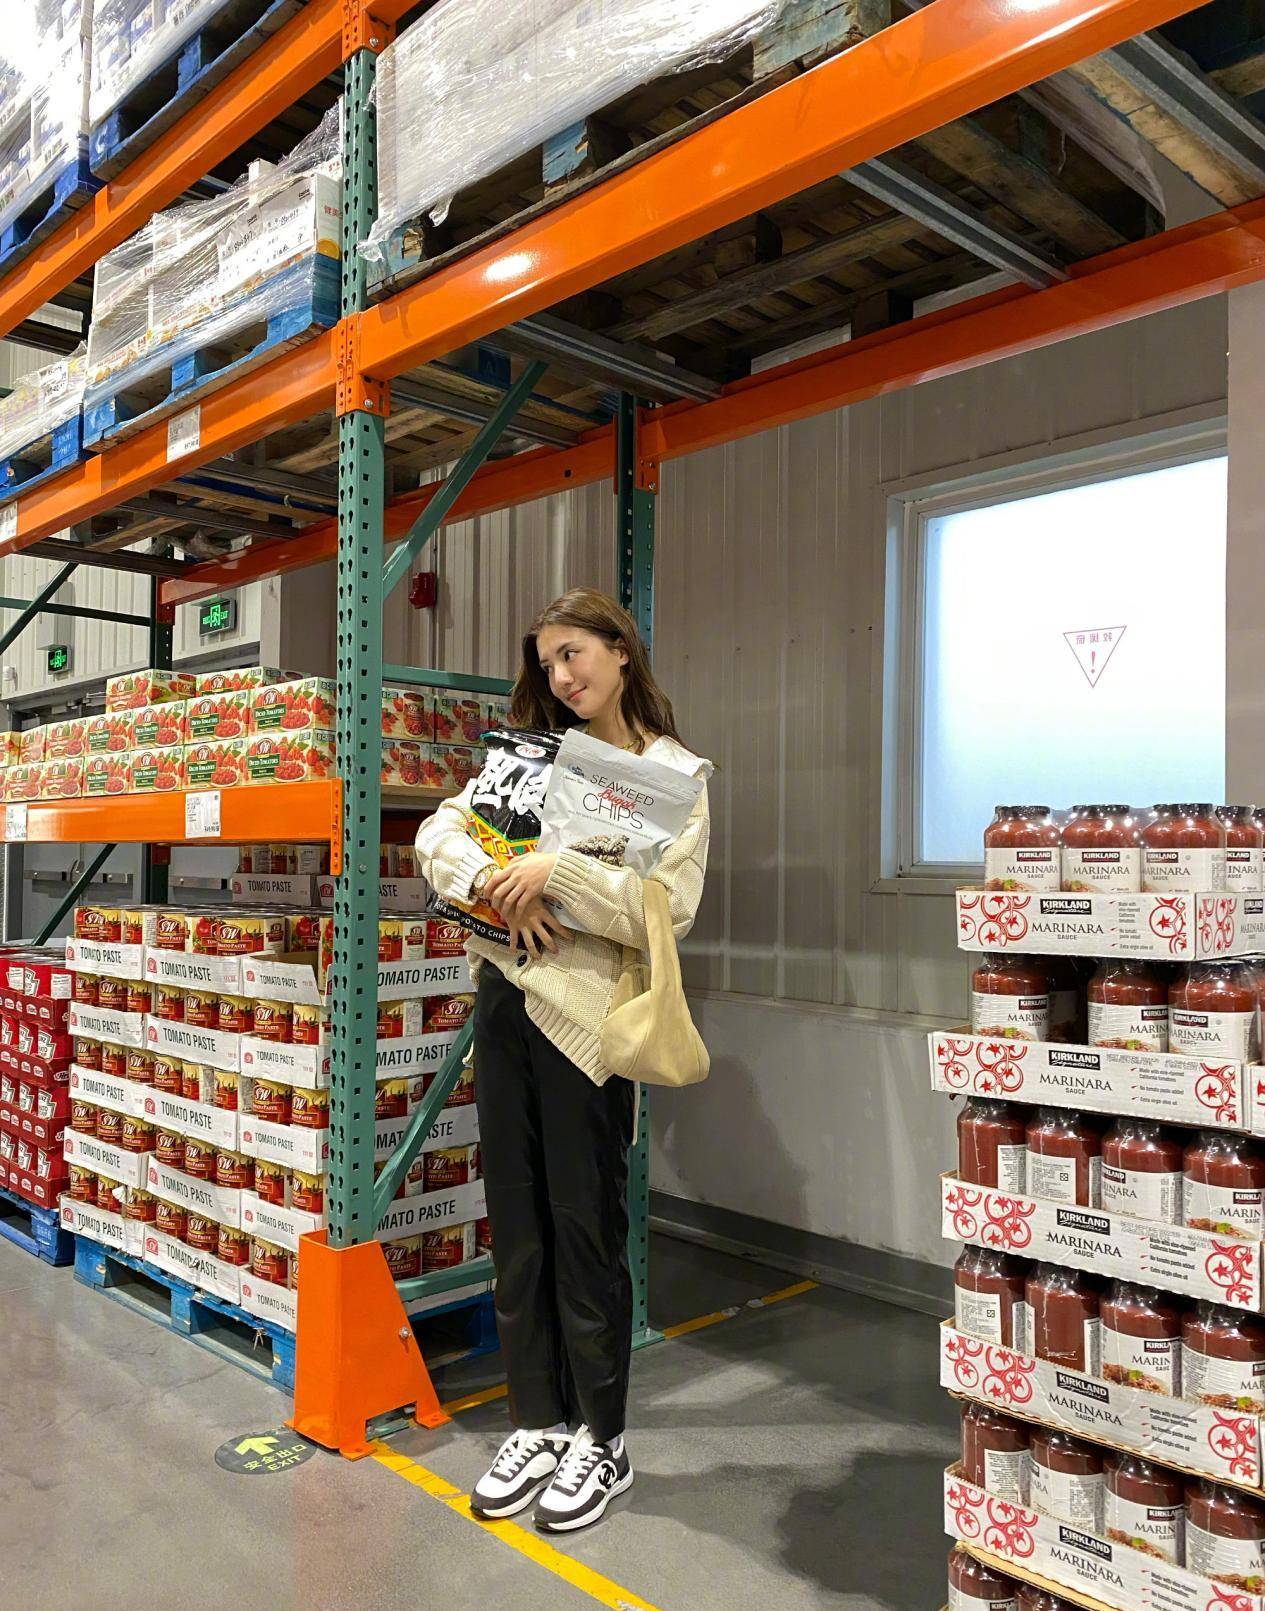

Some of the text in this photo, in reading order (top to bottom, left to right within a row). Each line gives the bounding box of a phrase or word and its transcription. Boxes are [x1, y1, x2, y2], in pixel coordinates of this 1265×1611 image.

[590, 774, 654, 806] SEAWEED
[583, 792, 644, 830] CHIPS
[1006, 866, 1058, 874] MARINARA
[1074, 866, 1130, 875] MARINARA
[248, 880, 292, 893] TOMATO PASTE
[379, 884, 398, 897] ASTE
[1043, 900, 1090, 910] KIRKLAND
[488, 930, 510, 942] CHIPS
[1032, 922, 1104, 934] MARINARA
[80, 946, 122, 964] TOMATO PASTE
[160, 962, 212, 982] TOMATO PASTE
[378, 966, 460, 986] OMATO PASTE
[260, 975, 298, 988] TOMATO PASTE
[80, 1016, 120, 1035] TOMATO PASTE
[1174, 1014, 1208, 1023] KIRKLAND
[1130, 1024, 1168, 1034] MARIN
[163, 1028, 216, 1053] TOMATO PASTE
[256, 1050, 294, 1066] TOMATO PASTE
[376, 1050, 412, 1066] MATO
[1051, 1052, 1098, 1063] KIRKLAND
[83, 1078, 124, 1102] TOMATO PASTE
[1040, 1072, 1112, 1091] MARINARA
[162, 1101, 212, 1130] TOMATO PASTE
[255, 1132, 294, 1152] TOMATO PASTE
[80, 1142, 120, 1168] TOMATO PASTE
[162, 1174, 213, 1208] TOMATO PASTE
[378, 1200, 456, 1231] MATO PASTE
[1060, 1211, 1108, 1228] KIRKLAND
[1220, 1208, 1260, 1218] MARIN
[78, 1213, 122, 1240] TOMATO PASTE
[256, 1212, 294, 1234] TOMATO PASTE
[1047, 1232, 1122, 1258] MARINARA
[1074, 1248, 1094, 1258] SAUCE
[258, 1294, 296, 1318] TOMATO PASTE
[1132, 1355, 1170, 1366] MARIN
[1059, 1374, 1107, 1396] KIRKLAND
[1050, 1392, 1123, 1426] MARINARA
[1075, 1412, 1096, 1424] SAUCE
[243, 1444, 308, 1470] 安全出口
[267, 1454, 301, 1470] EXIT
[1134, 1522, 1176, 1535] MARIN
[1062, 1528, 1110, 1554] KIRKLAND
[1050, 1547, 1125, 1588] MARINARA
[1076, 1568, 1098, 1582] SAUCE
